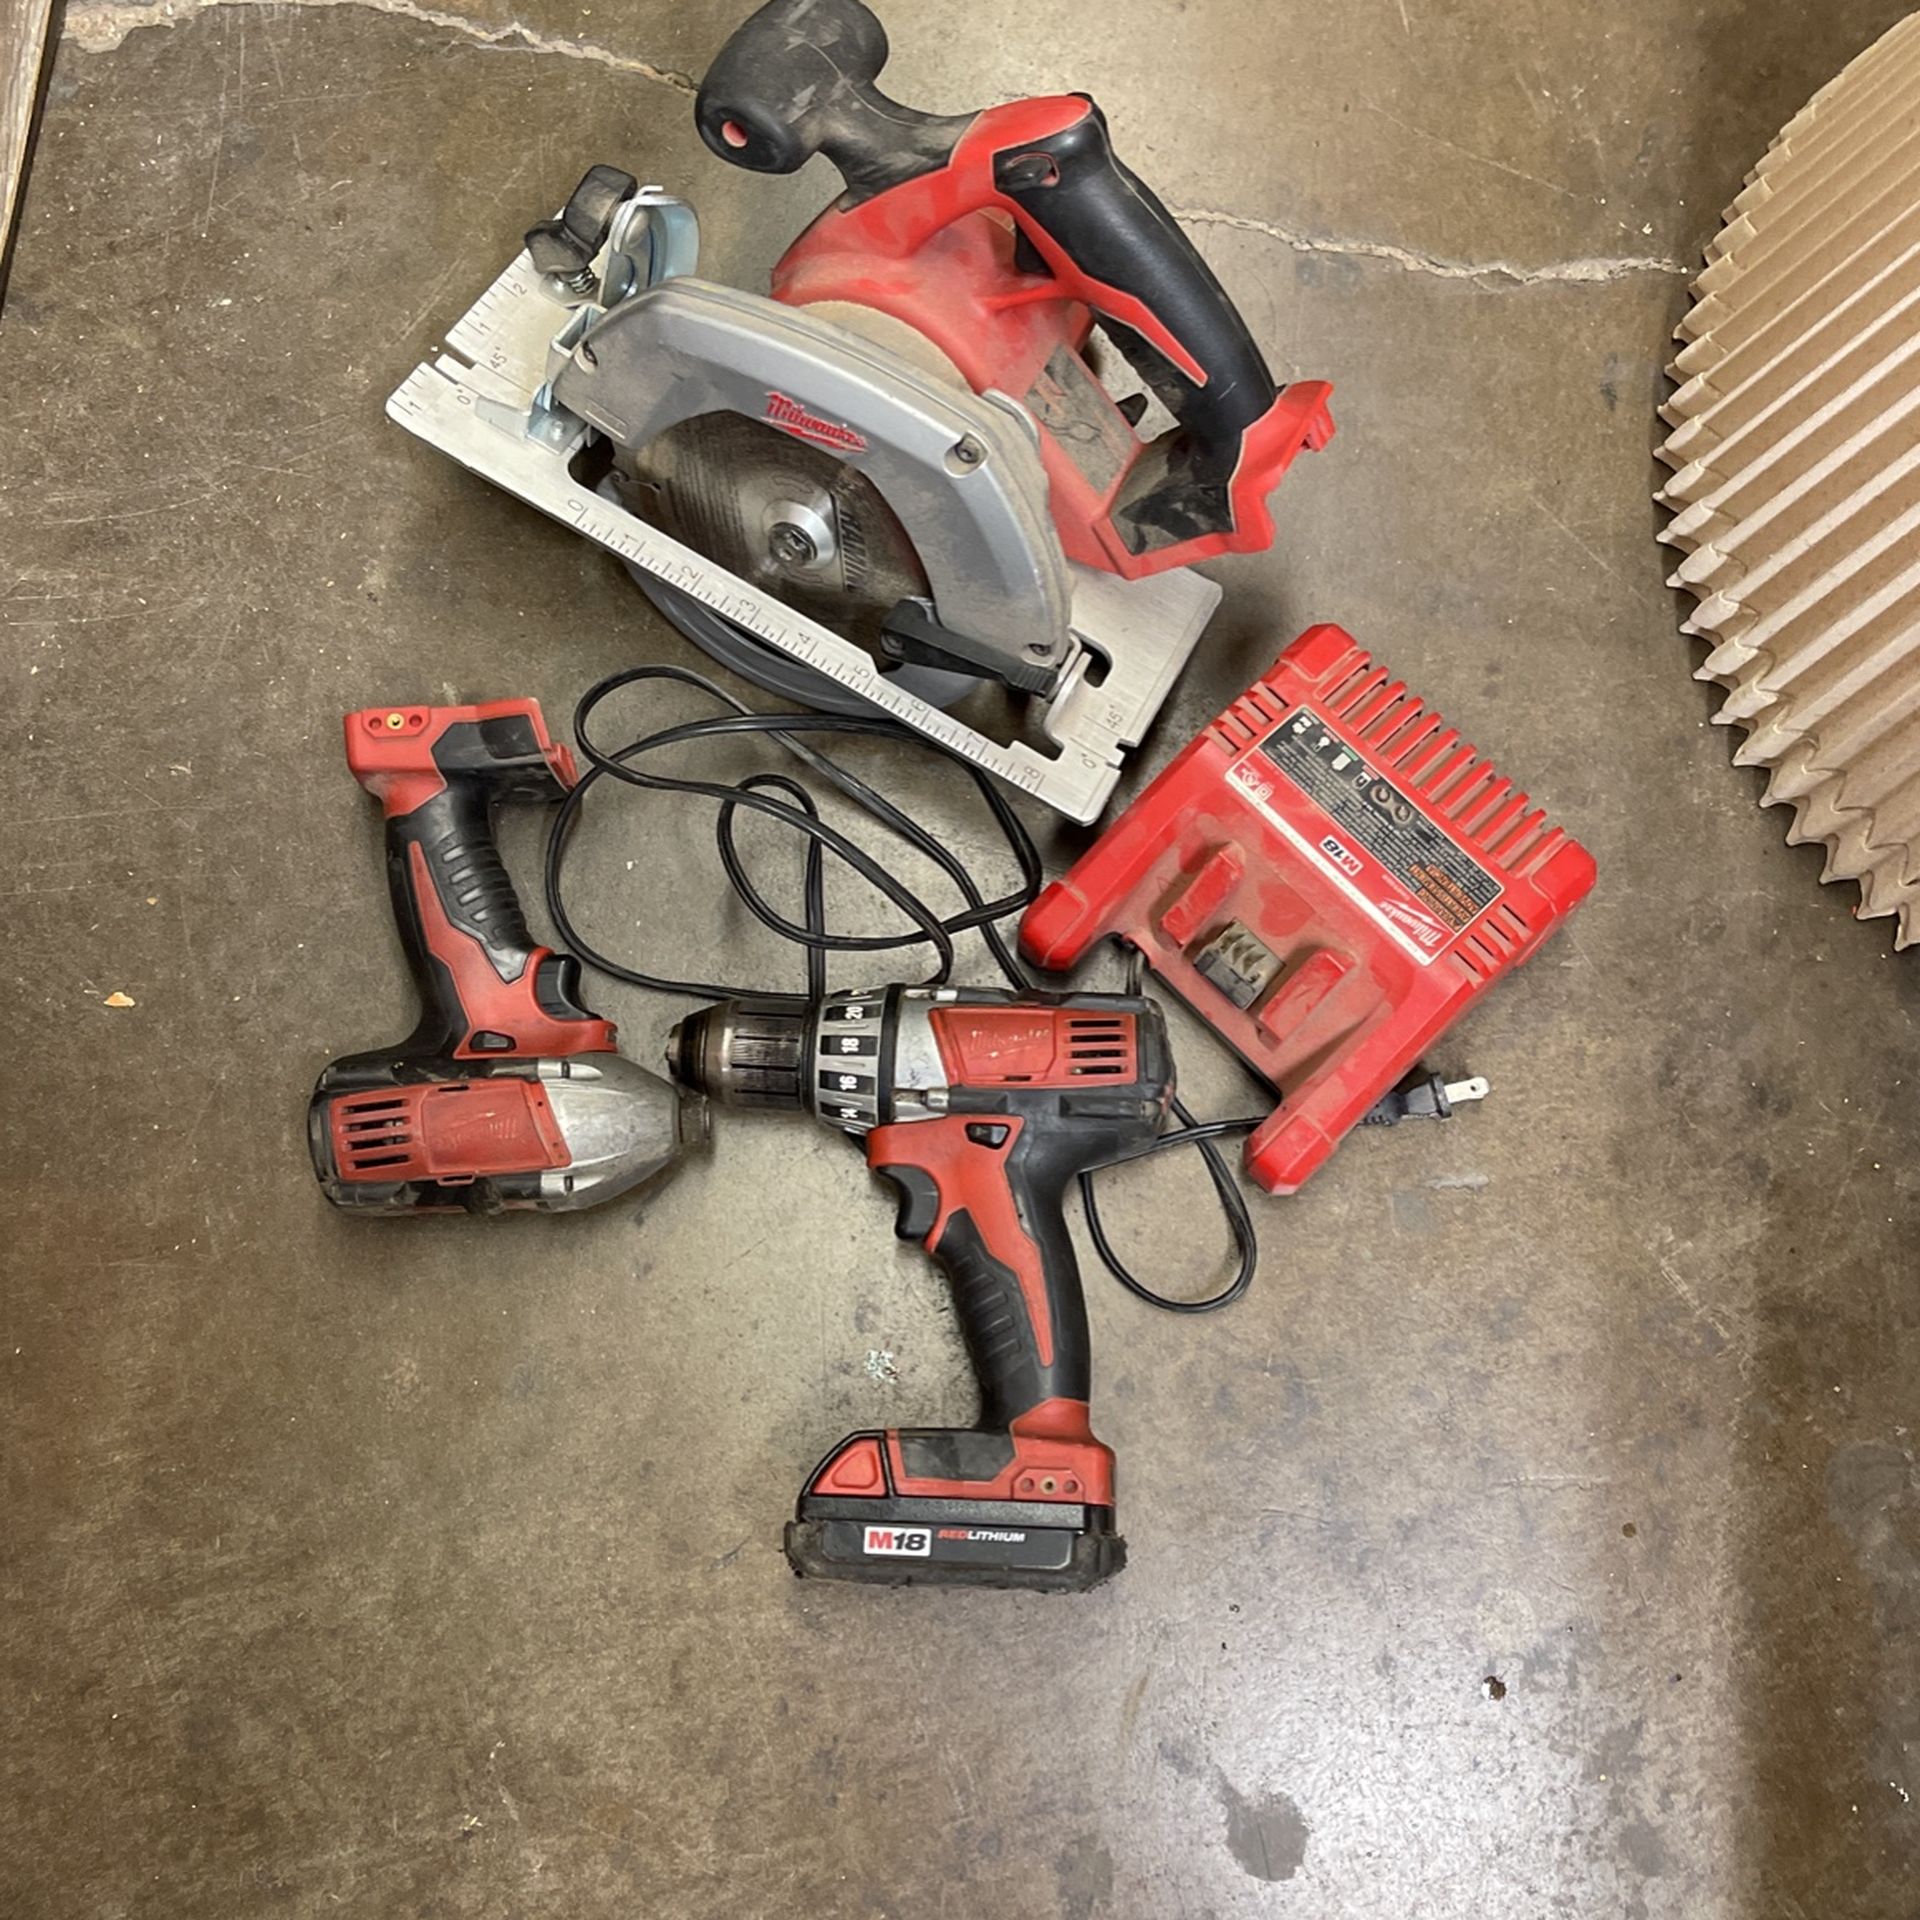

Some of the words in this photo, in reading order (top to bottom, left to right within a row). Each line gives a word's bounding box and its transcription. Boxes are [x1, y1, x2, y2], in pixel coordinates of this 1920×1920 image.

[513, 282, 528, 296] 2
[765, 391, 867, 449] Milwaukee
[624, 533, 639, 544] 1
[681, 565, 697, 579] 2
[740, 599, 756, 613] 3
[798, 632, 812, 645] 4
[853, 666, 870, 680] 5
[910, 700, 928, 713] 6
[968, 731, 984, 745] 7
[1023, 765, 1040, 780] 8
[1322, 839, 1360, 872] M18
[1379, 901, 1443, 947] Milwaukee
[844, 1005, 863, 1020] 20
[841, 1037, 860, 1053] 18
[839, 1074, 857, 1090] 16
[840, 1107, 858, 1119] 14
[868, 1531, 927, 1551] M18
[937, 1529, 1026, 1542] REDLITHIUM
